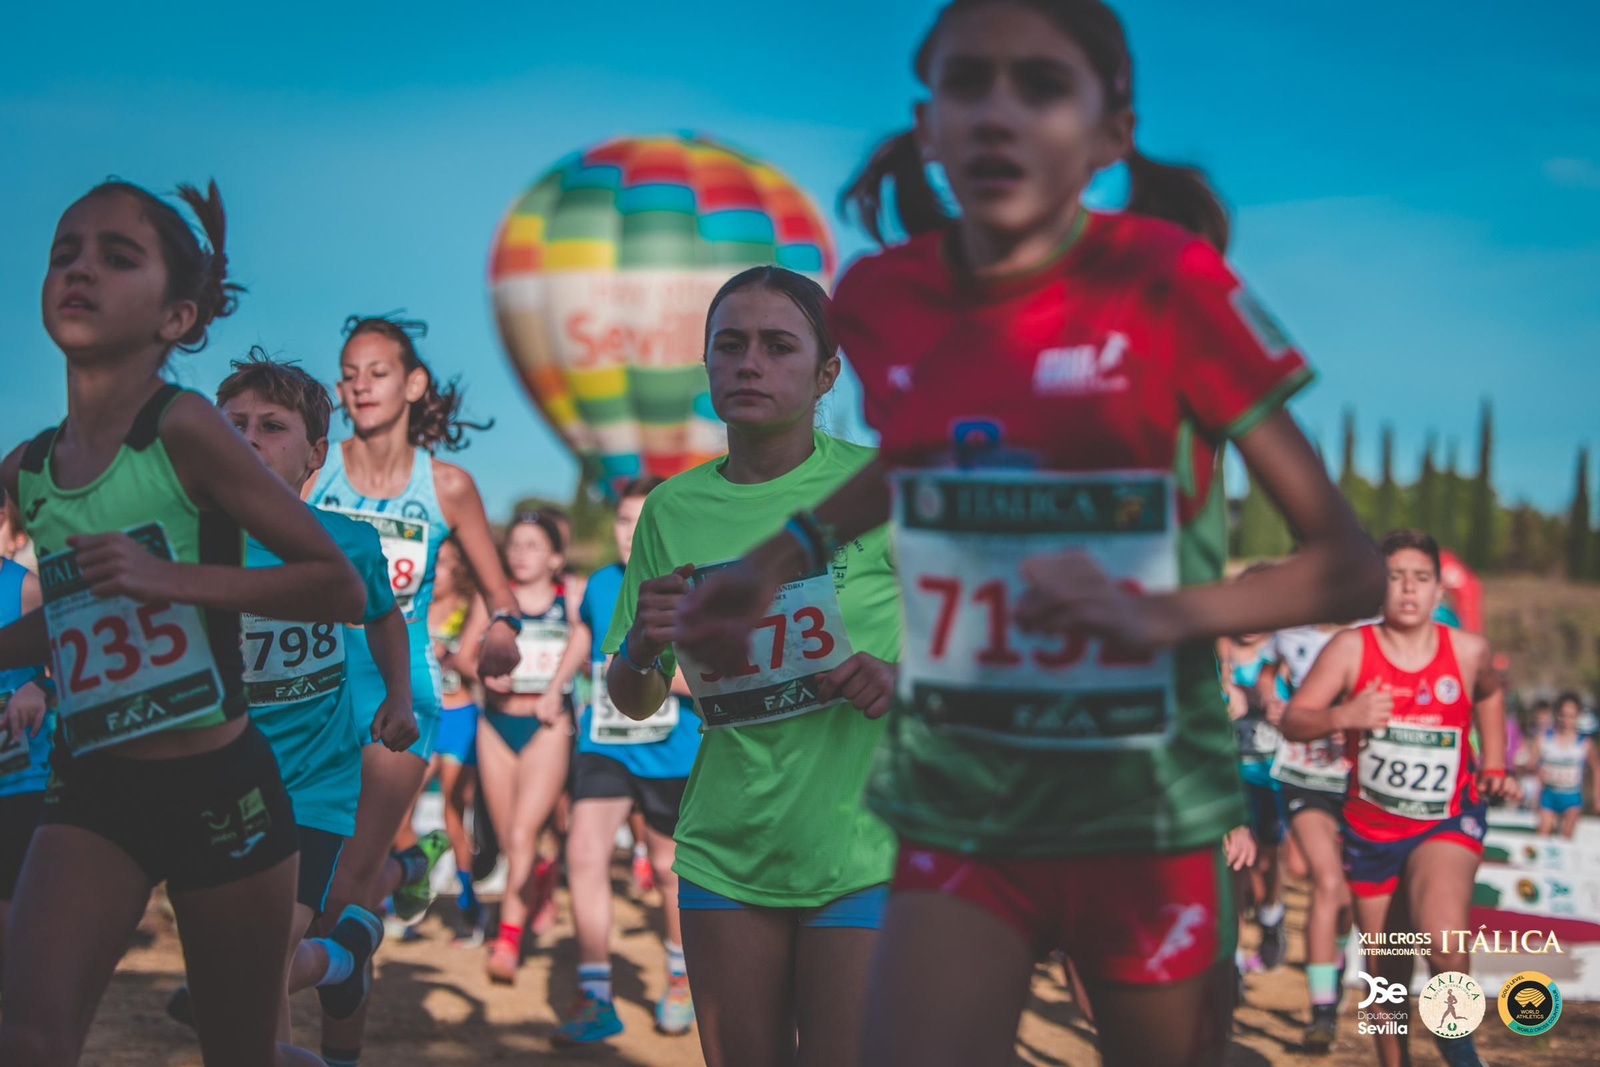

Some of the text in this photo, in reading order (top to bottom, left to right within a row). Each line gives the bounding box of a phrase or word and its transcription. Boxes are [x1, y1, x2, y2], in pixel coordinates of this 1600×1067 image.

[392, 558, 414, 590] 8
[775, 582, 804, 593] ANDRO
[1369, 754, 1449, 792] 7822
